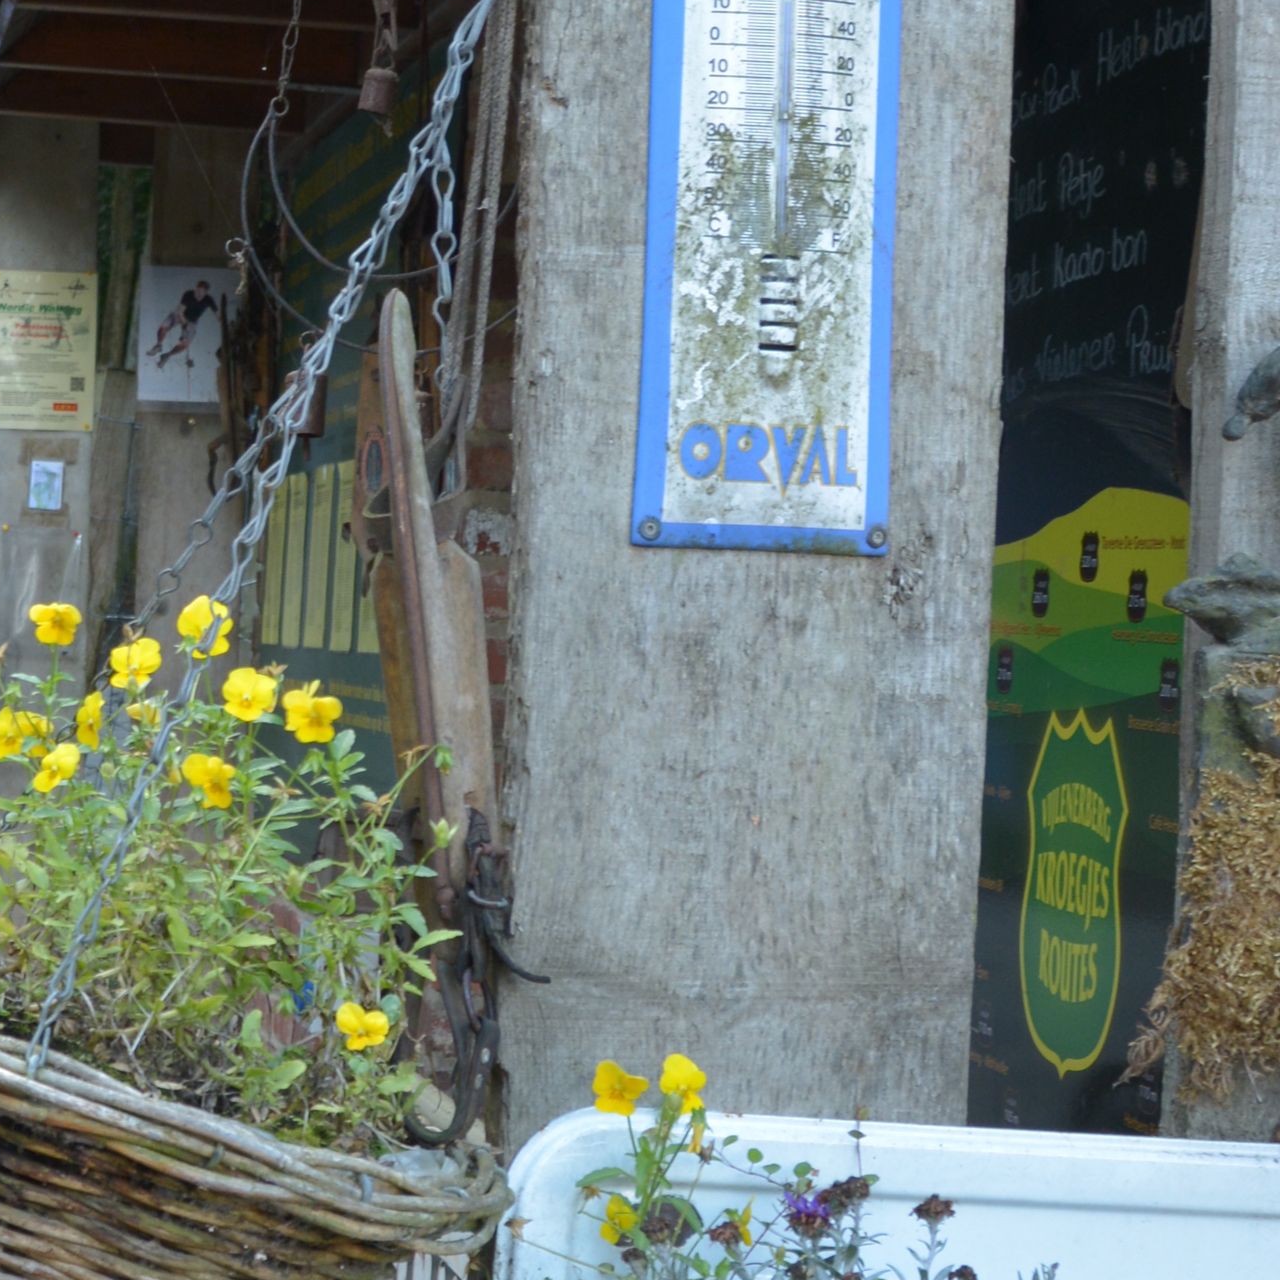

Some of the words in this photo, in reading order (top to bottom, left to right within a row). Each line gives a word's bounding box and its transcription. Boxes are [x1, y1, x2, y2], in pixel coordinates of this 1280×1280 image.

[709, 26, 720, 41] 0
[838, 21, 856, 36] 40
[709, 58, 728, 73] 10
[837, 56, 855, 72] 20
[707, 90, 728, 105] 20
[845, 92, 854, 107] 0
[706, 122, 728, 137] 30
[835, 127, 853, 142] 20
[705, 155, 727, 169] 40
[833, 163, 852, 178] 40
[1056, 152, 1108, 222] Petje
[709, 217, 722, 233] C
[1006, 251, 1044, 307] ert
[1052, 226, 1149, 289] Kado-bon
[678, 419, 860, 498] ORVAL
[1035, 850, 1110, 933] KROEGJES
[1038, 927, 1098, 1003] ROUTES
